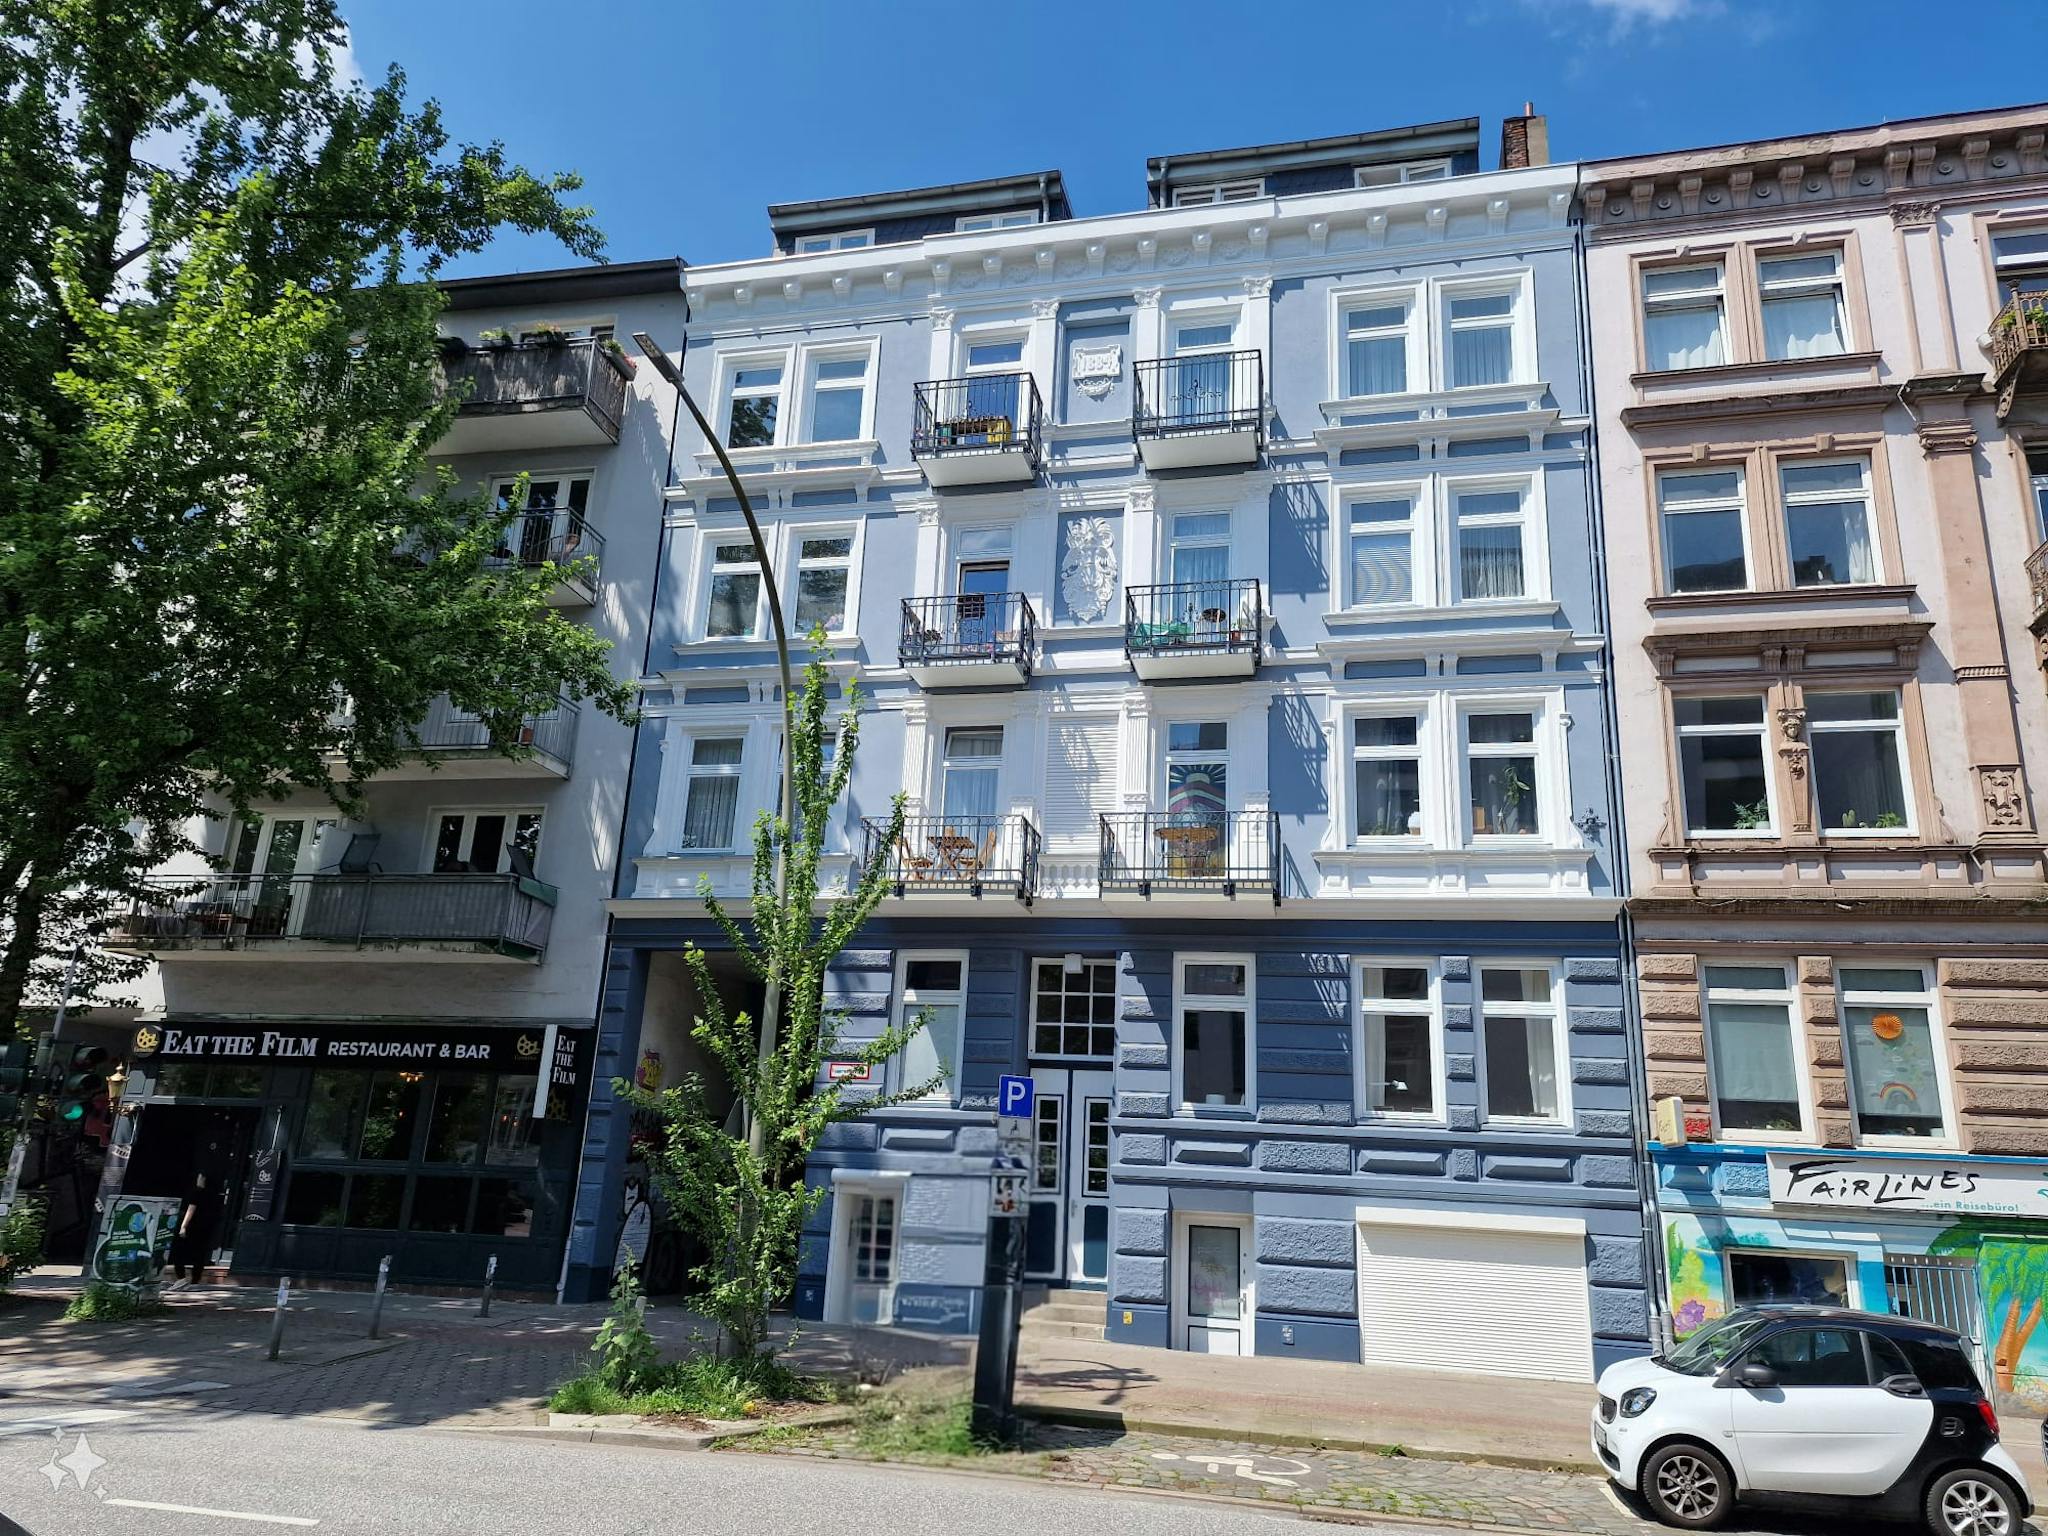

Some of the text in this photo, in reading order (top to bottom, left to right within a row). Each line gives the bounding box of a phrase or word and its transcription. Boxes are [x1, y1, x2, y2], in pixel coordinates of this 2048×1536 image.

[160, 1030, 491, 1059] EAT THE FILM RESTAURANT & BAR
[557, 1035, 576, 1052] EAT
[555, 1052, 574, 1067] THE
[553, 1066, 576, 1085] FILM
[1007, 1081, 1026, 1111] P
[1956, 1201, 2019, 1212] Reisebüro!
